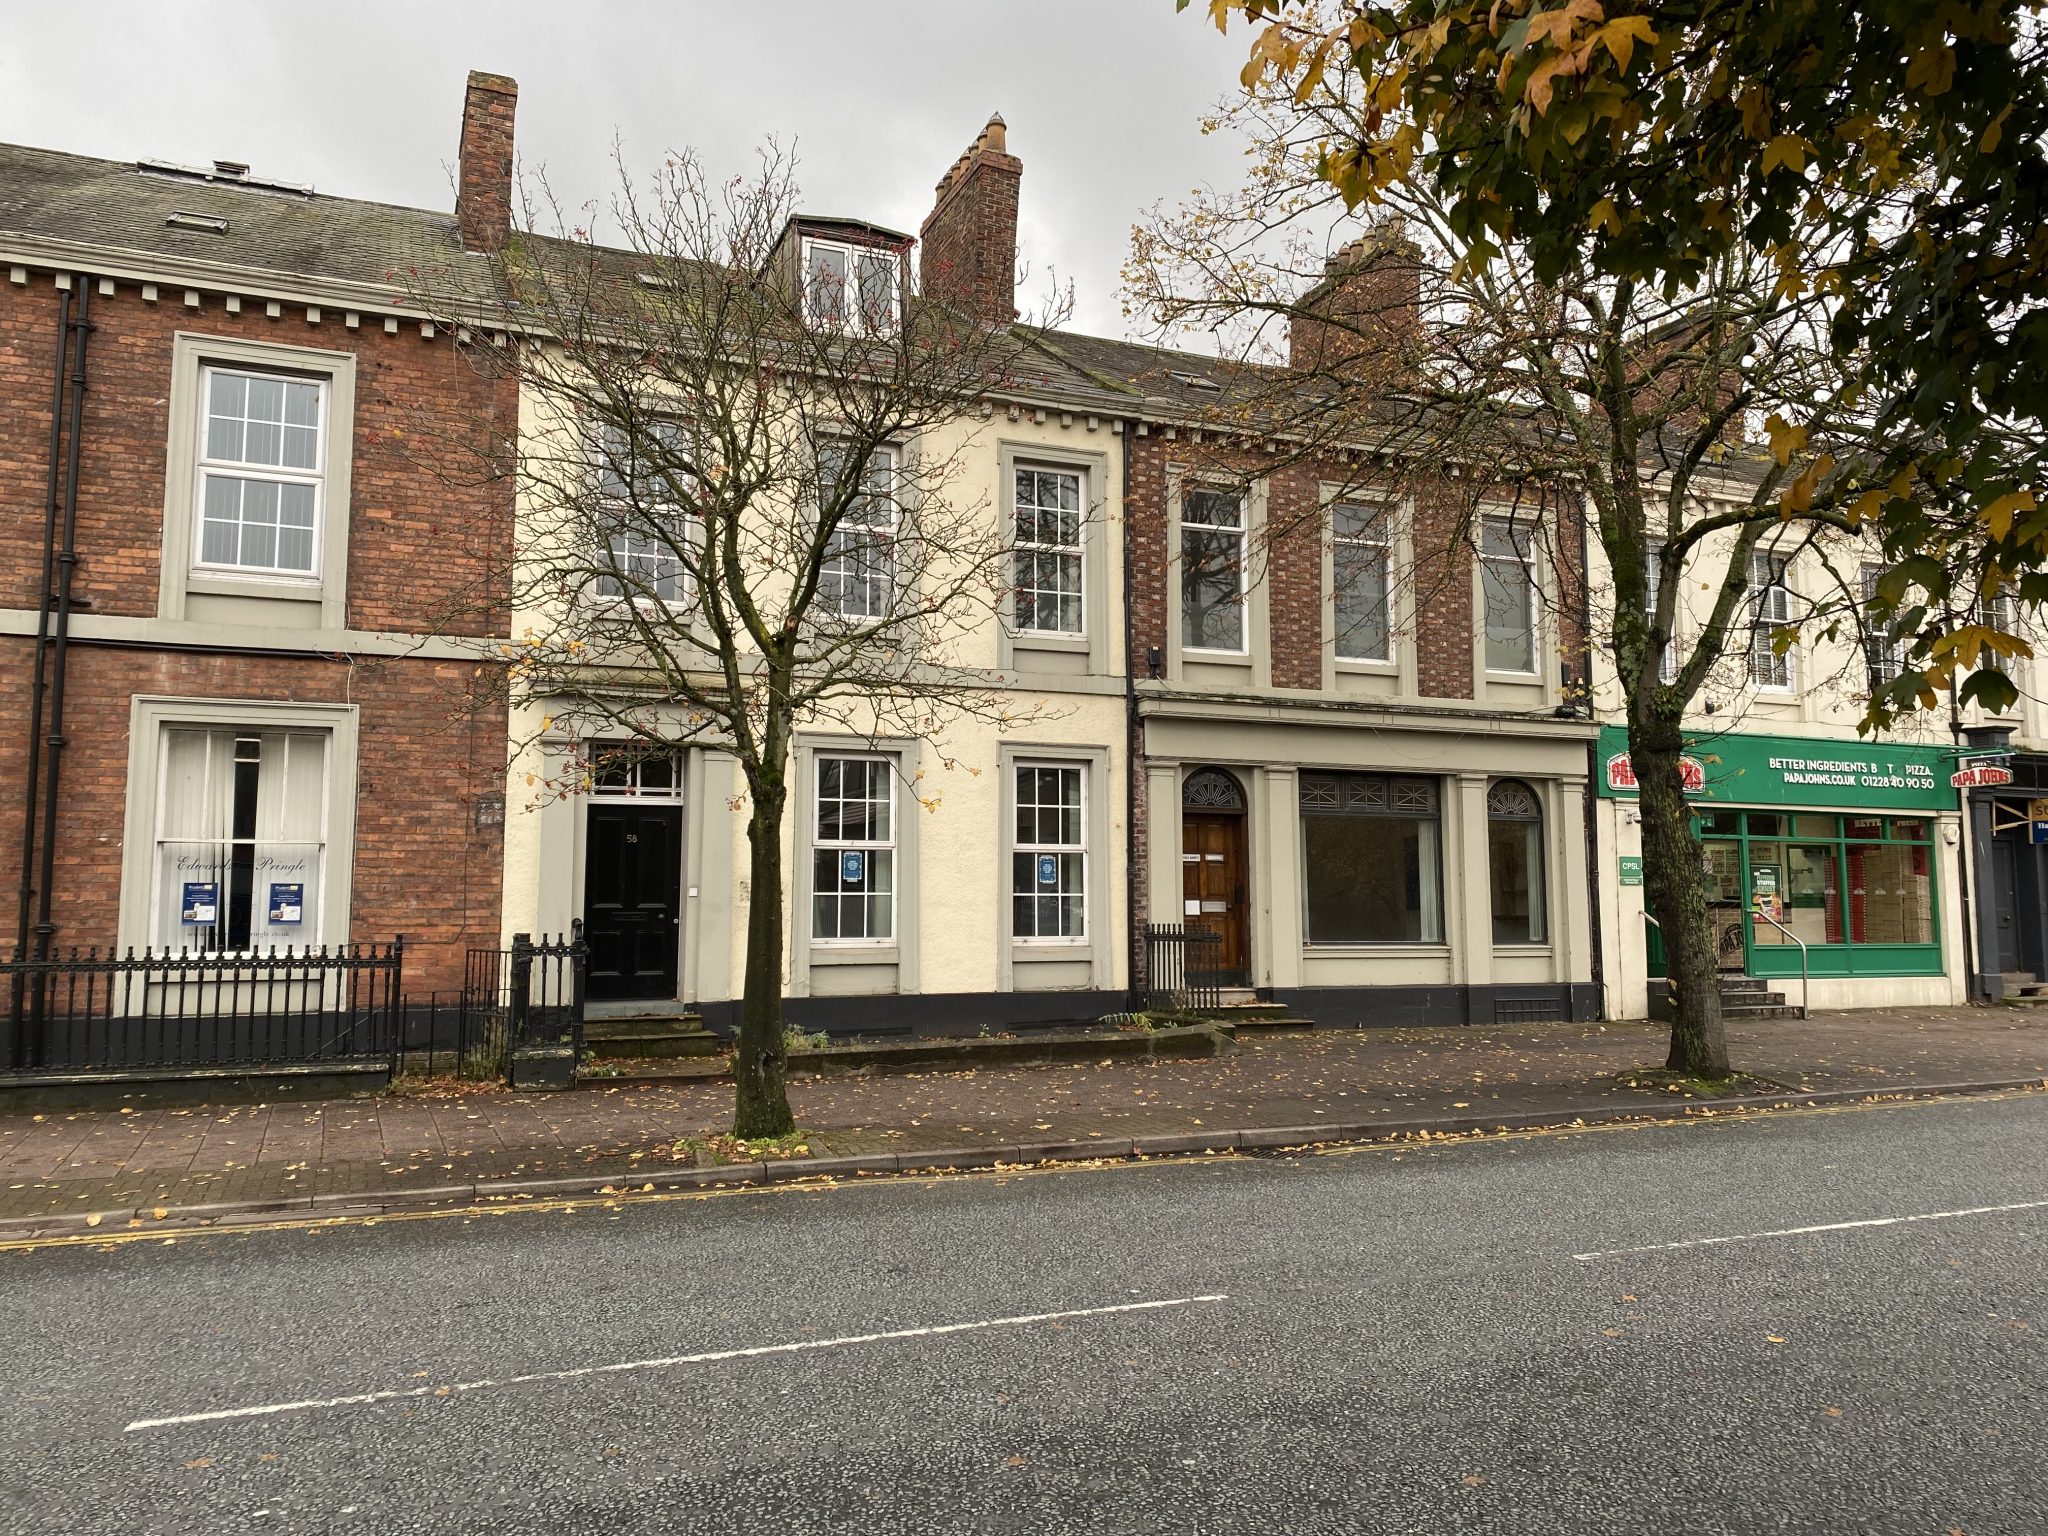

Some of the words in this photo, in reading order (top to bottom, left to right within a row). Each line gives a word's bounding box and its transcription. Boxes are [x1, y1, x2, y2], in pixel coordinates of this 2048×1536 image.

[1769, 757, 1806, 770] BETTER
[1807, 760, 1868, 773] INGREDIENTS
[1905, 764, 1934, 776] PIZZA.
[1783, 772, 1856, 786] PAPAJOHNS.CO.UK
[1861, 775, 1889, 788] 01228
[1906, 778, 1920, 789] 90
[1920, 778, 1935, 789] 50
[1952, 769, 1977, 786] PAPA
[1978, 768, 2010, 785] JOHNS
[626, 834, 638, 843] 58
[177, 855, 232, 871] Edwards
[255, 856, 306, 876] Pringle
[1622, 862, 1640, 870] CPSL
